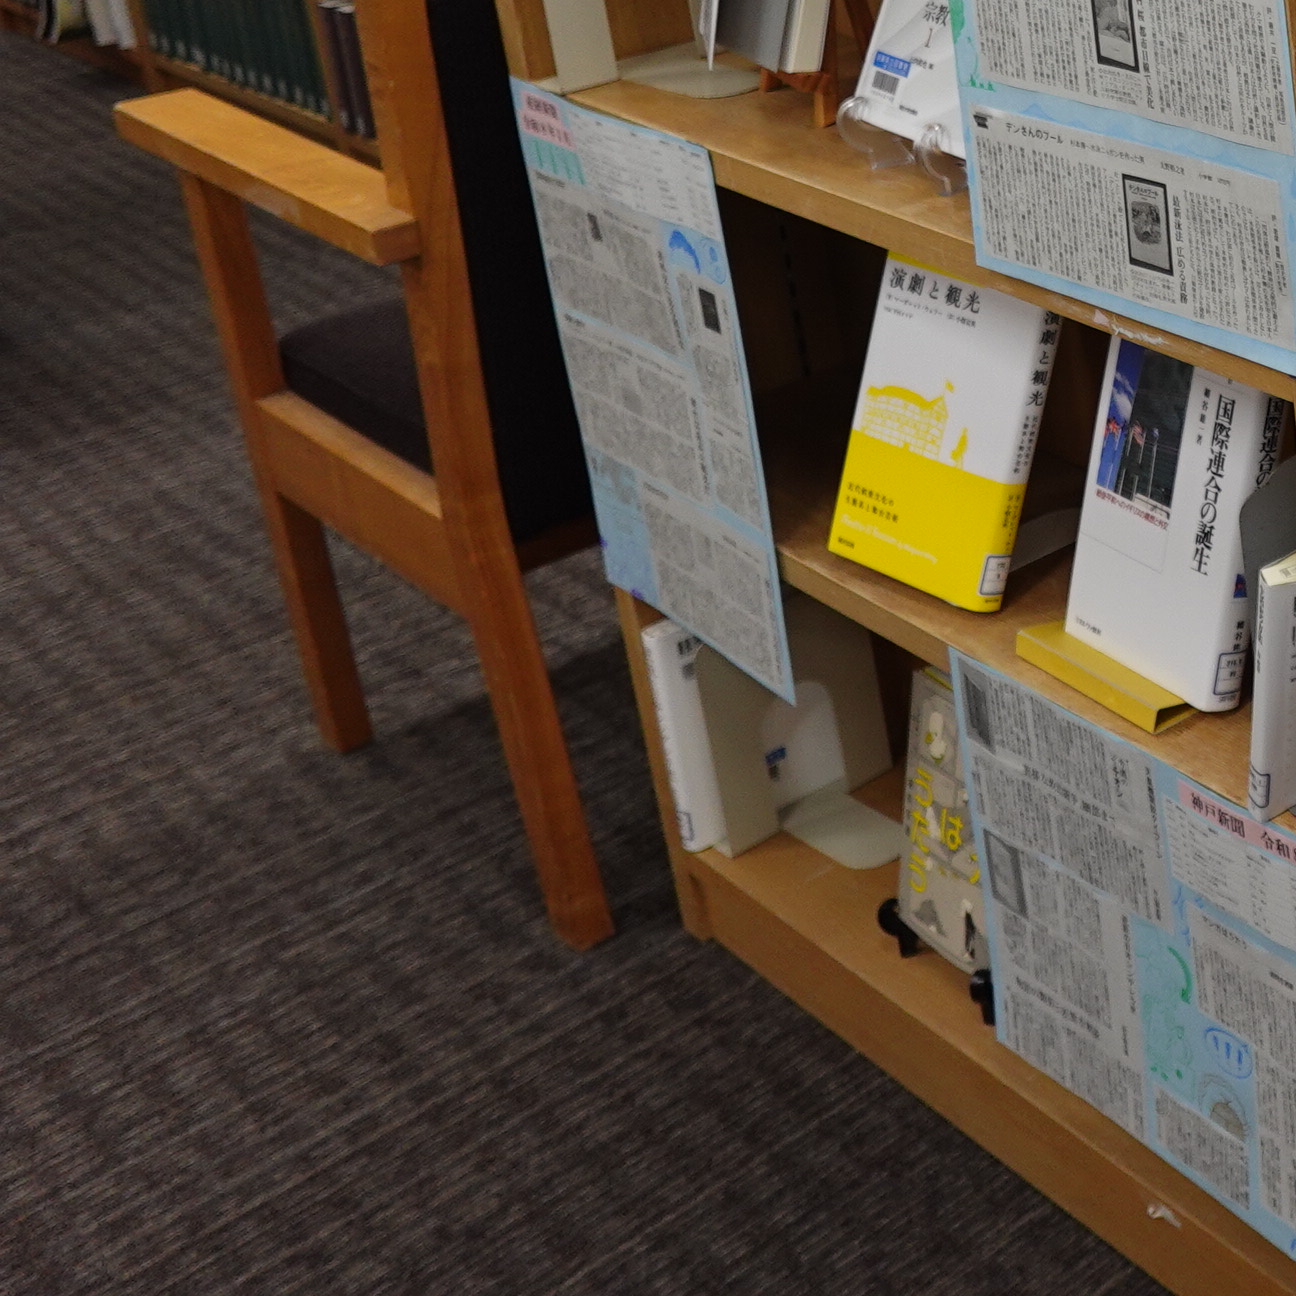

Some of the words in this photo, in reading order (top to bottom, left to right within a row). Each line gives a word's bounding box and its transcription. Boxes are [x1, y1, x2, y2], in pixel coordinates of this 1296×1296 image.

[888, 267, 981, 315] 演劇と観光
[1190, 393, 1236, 577] 国際連合の誕生
[1190, 791, 1246, 840] 神戸新聞
